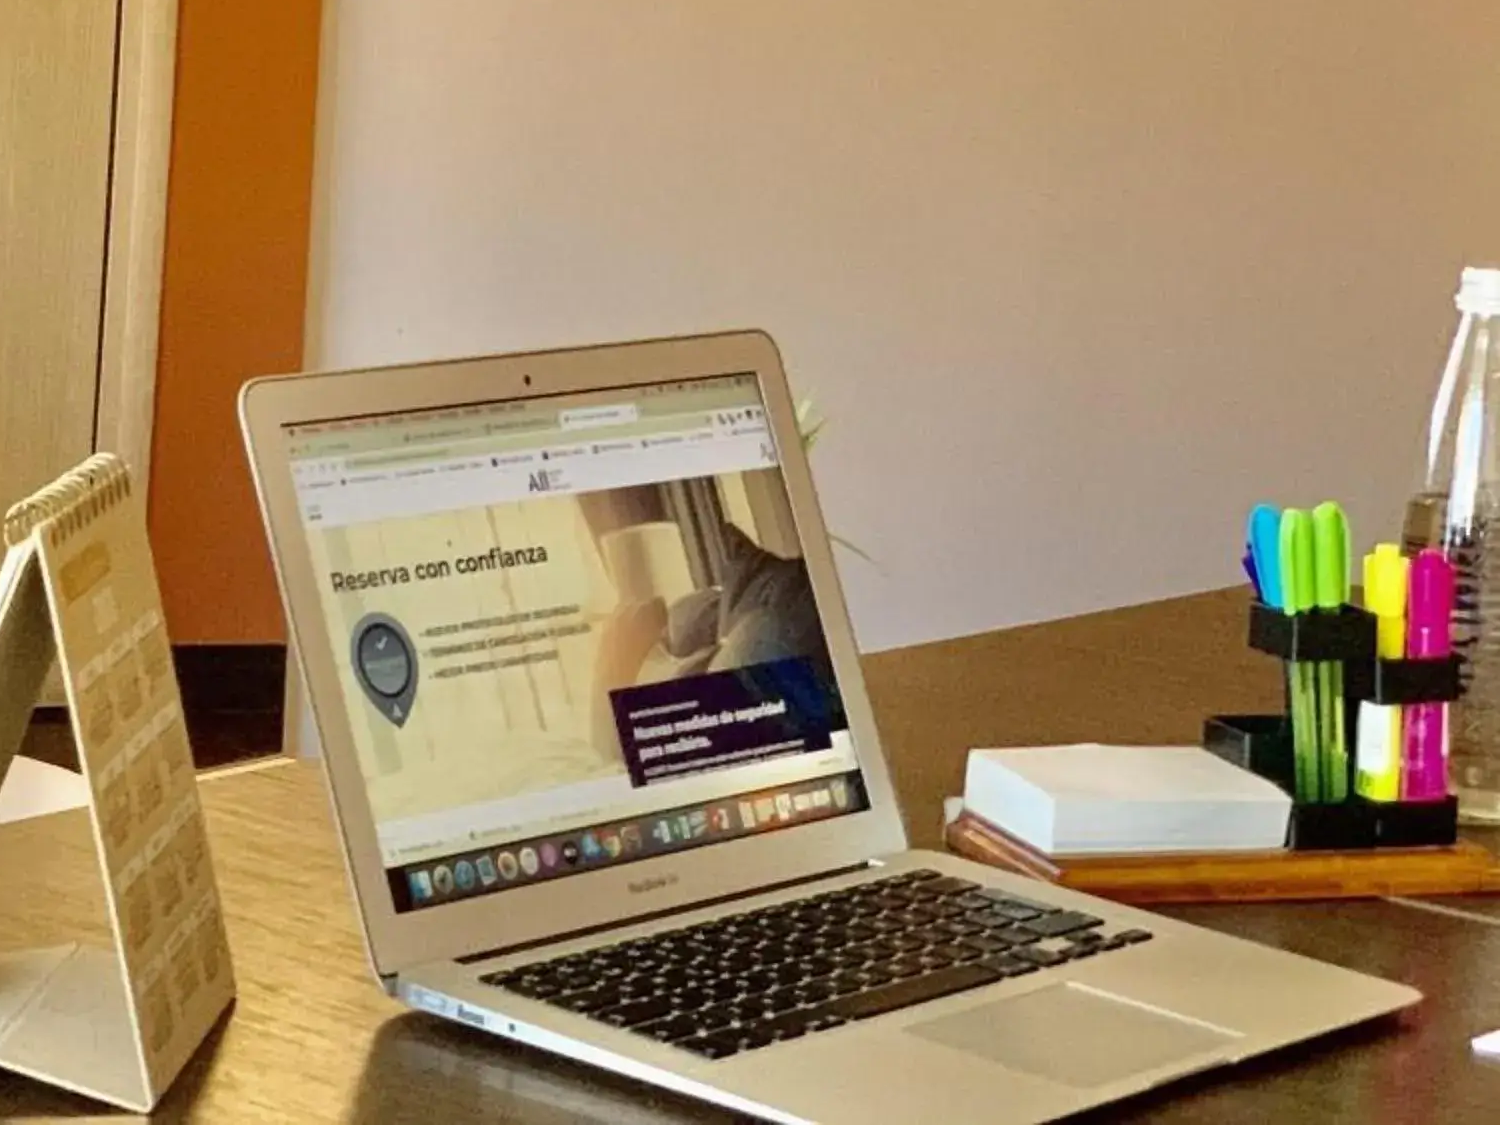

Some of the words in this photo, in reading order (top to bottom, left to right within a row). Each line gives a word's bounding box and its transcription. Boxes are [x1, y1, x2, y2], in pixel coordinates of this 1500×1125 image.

[331, 566, 411, 593] Reserva
[414, 559, 451, 581] con
[455, 544, 549, 575] confianza
